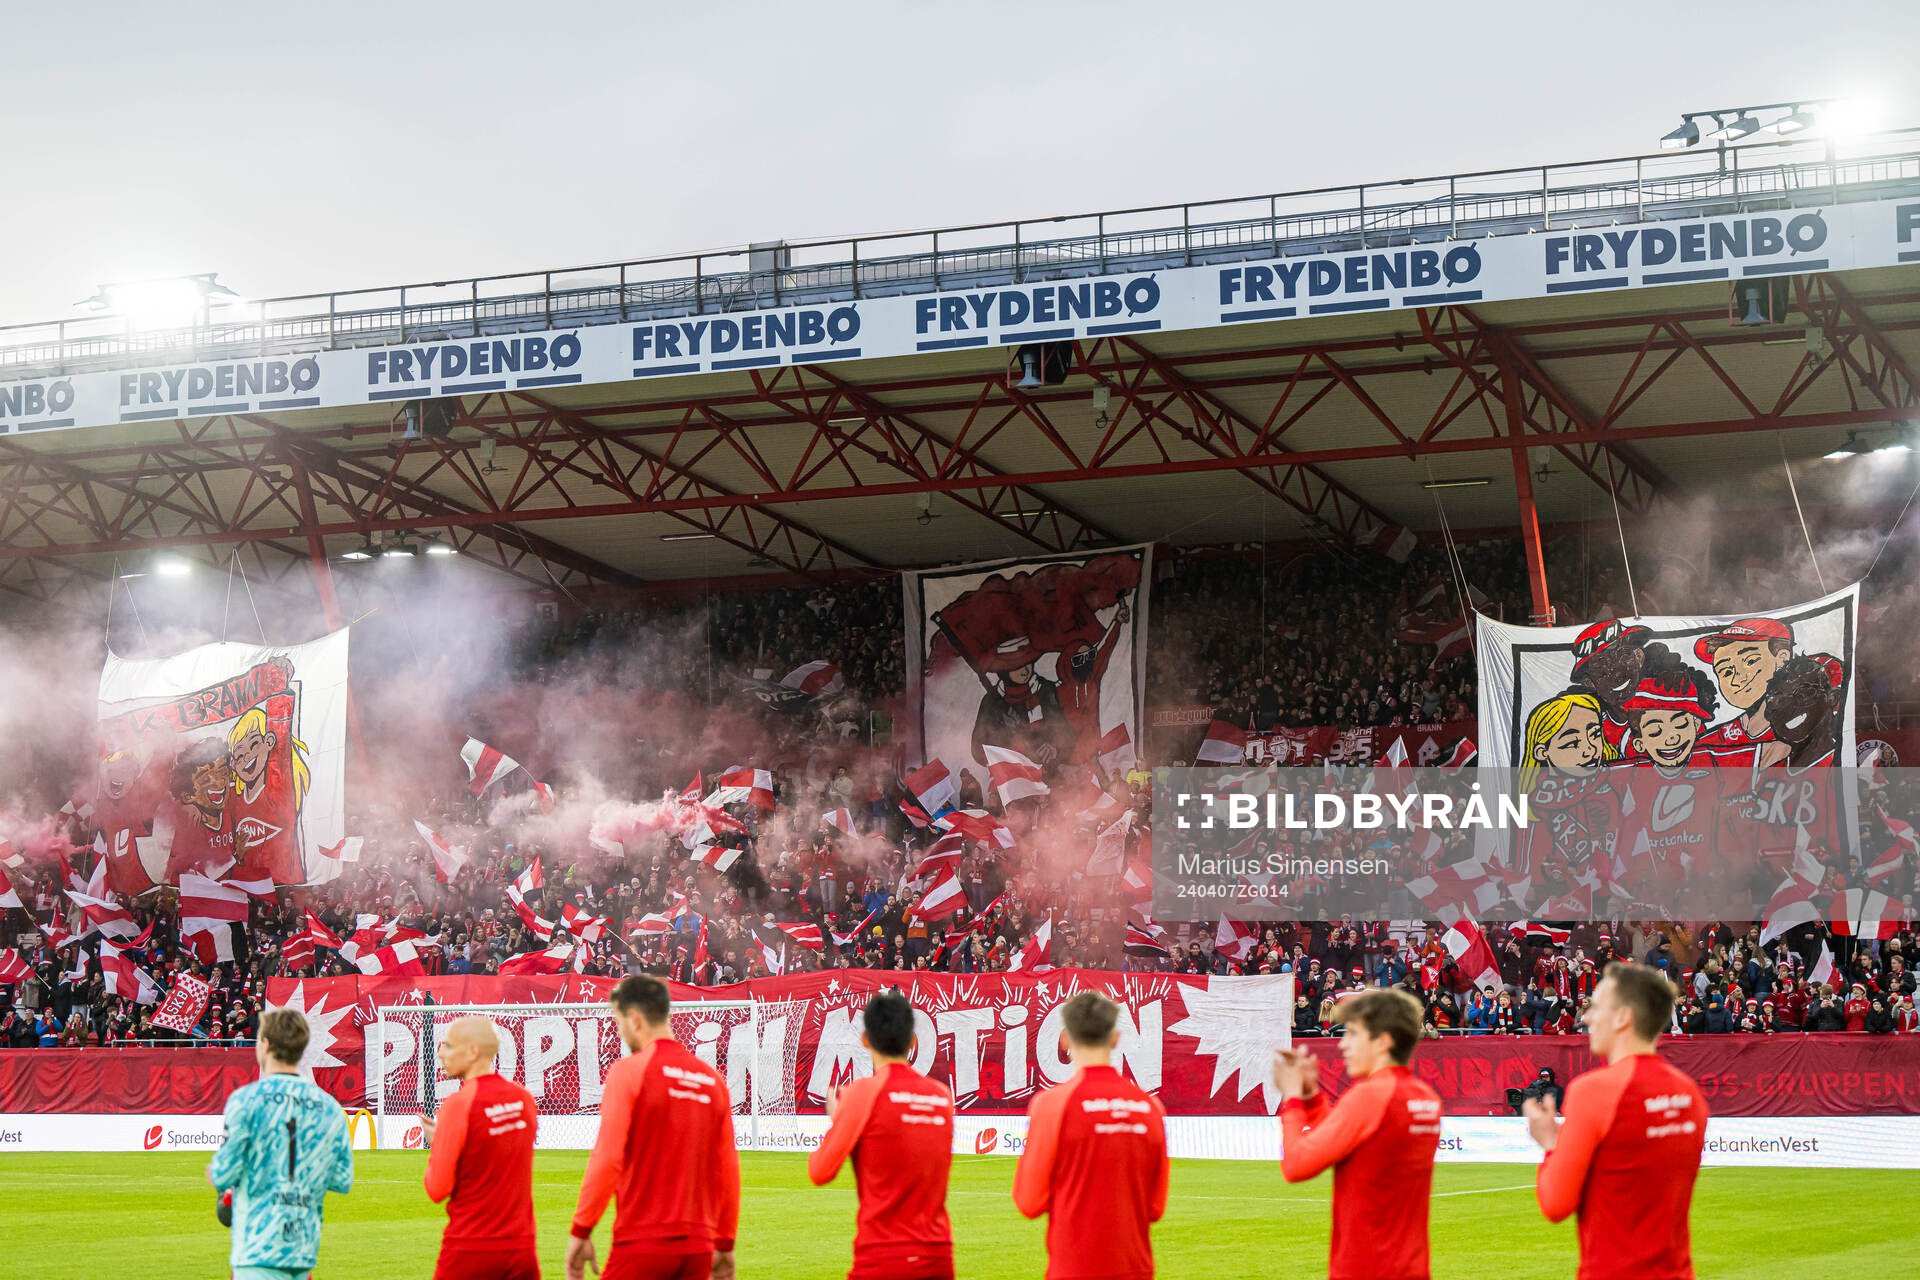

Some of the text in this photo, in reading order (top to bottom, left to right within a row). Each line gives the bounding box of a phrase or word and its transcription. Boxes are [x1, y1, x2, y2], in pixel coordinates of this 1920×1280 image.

[1546, 209, 1828, 275] FRYDENBØ
[1220, 241, 1482, 305] FRYDENBØ
[633, 303, 861, 361] FRYDENBØ
[916, 273, 1161, 334] FRYDENBØ
[120, 354, 320, 406] FRYDENBØ
[368, 330, 582, 384] FRYDENBØ
[166, 990, 189, 1015] SKB
